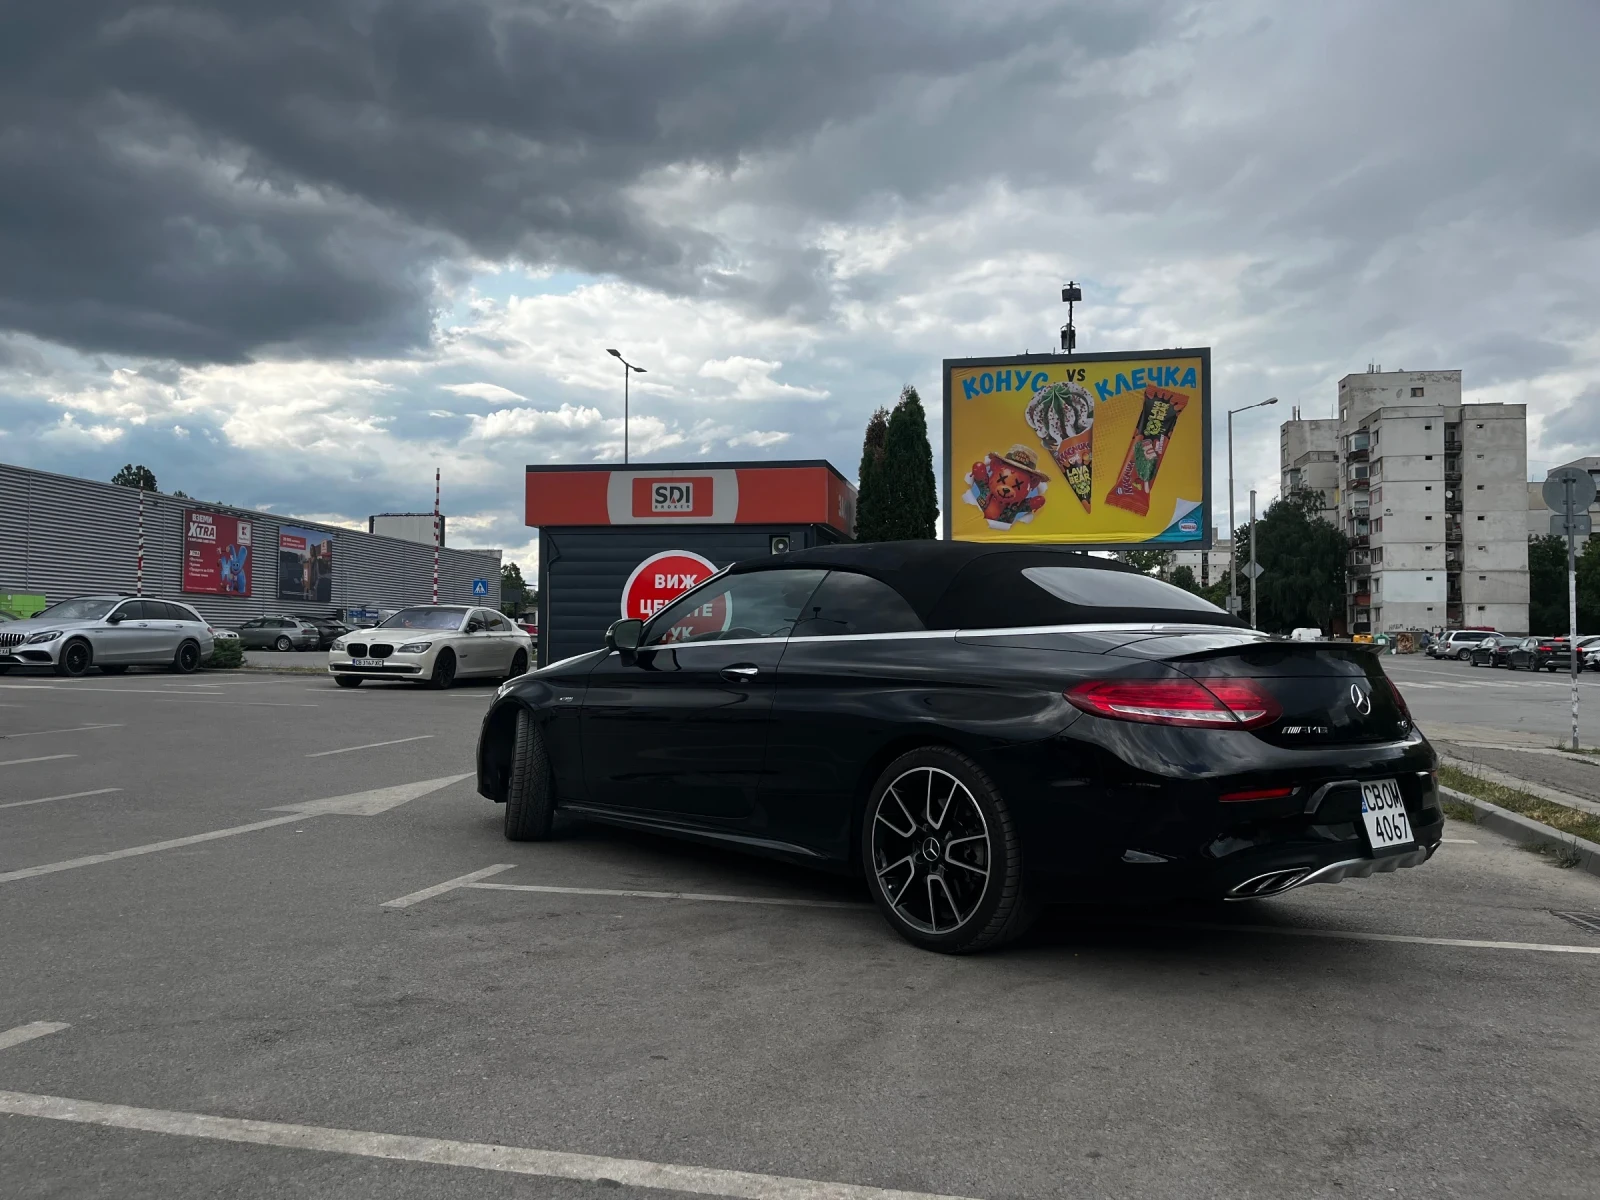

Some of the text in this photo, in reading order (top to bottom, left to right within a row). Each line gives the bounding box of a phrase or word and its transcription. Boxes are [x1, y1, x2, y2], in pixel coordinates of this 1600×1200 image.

[962, 366, 1197, 402] КОНУС VS КЛЕЧКА
[655, 486, 690, 504] SDI
[192, 513, 213, 524] ВЗЕМИ
[188, 522, 216, 540] XTRA
[654, 573, 698, 589] ВИЖ
[1375, 812, 1408, 843] 4067
